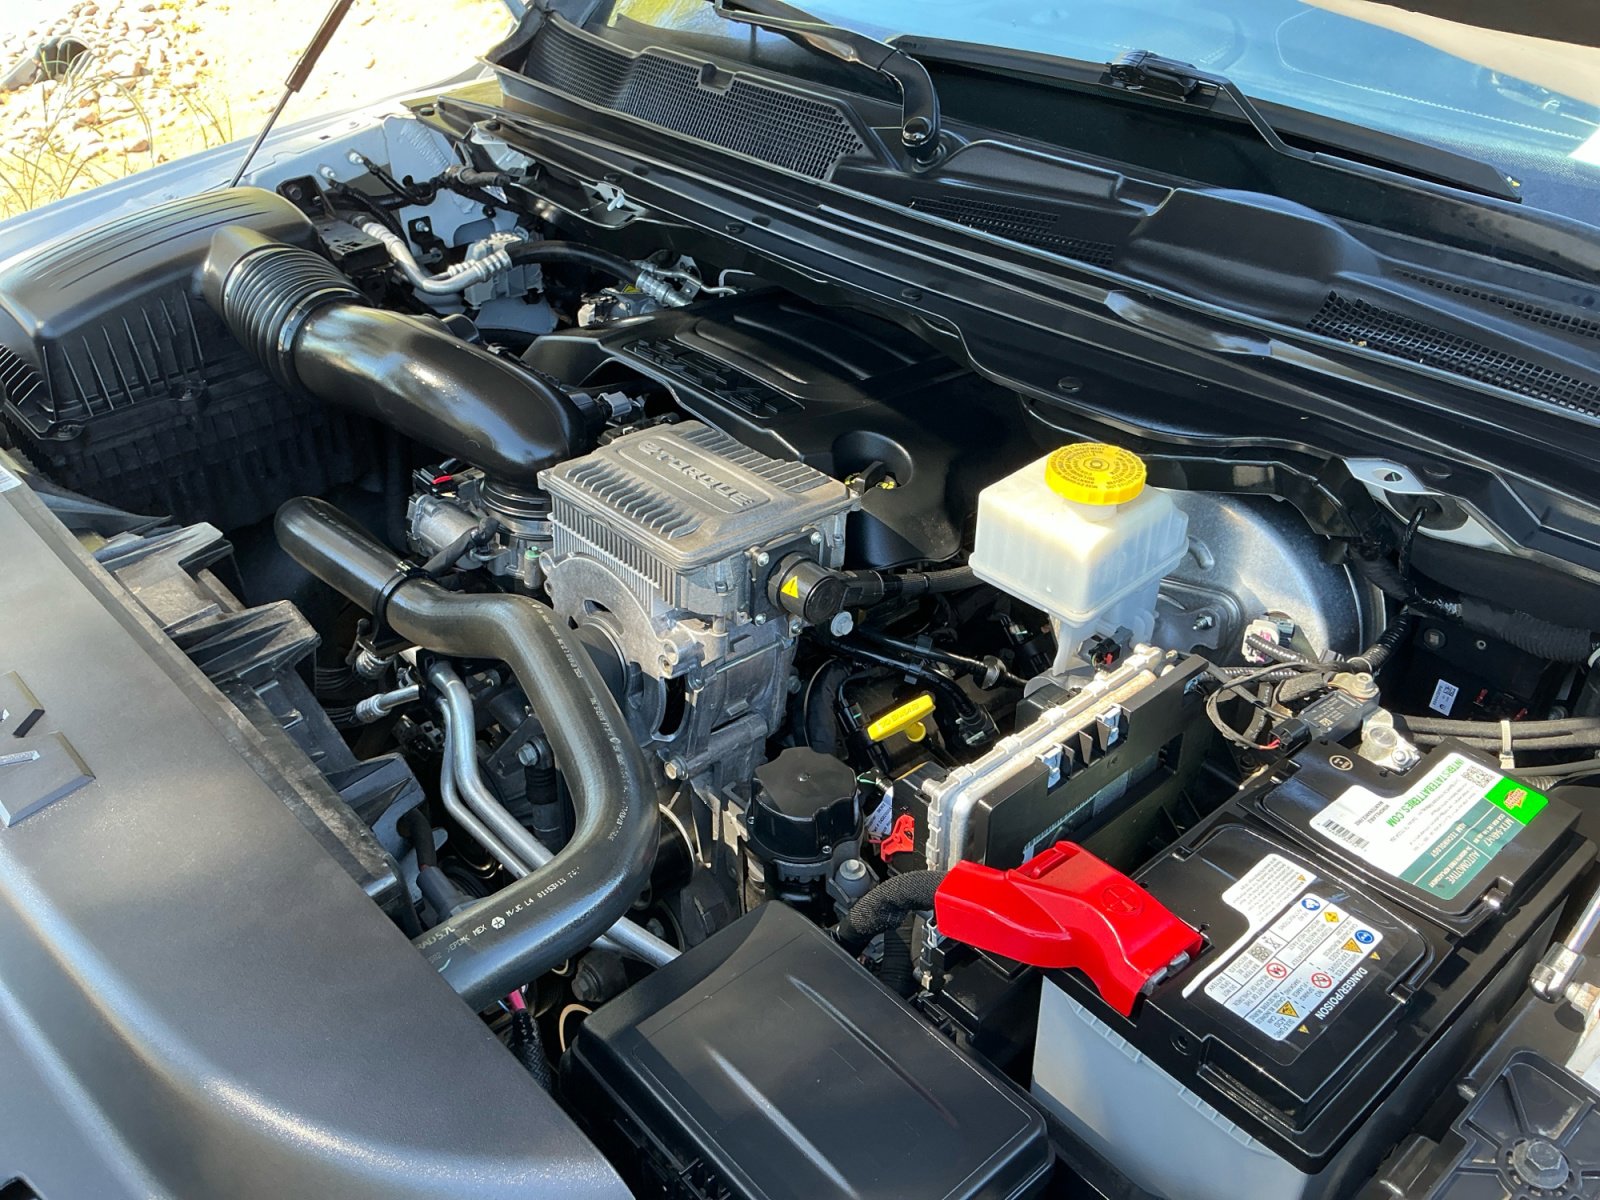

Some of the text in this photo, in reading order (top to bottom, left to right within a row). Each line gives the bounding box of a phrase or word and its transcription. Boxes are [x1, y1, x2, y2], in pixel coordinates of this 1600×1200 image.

[1384, 757, 1464, 827] INTERSTATEBATTERIES.COM
[1428, 830, 1459, 857] TECHNOLOGY
[1444, 849, 1481, 884] AUTOMOTIVE
[435, 926, 456, 941] 5.7L
[472, 924, 488, 937] MEX
[1313, 989, 1324, 997] NO
[1314, 966, 1368, 1020] DANGER/POISON
[1273, 1016, 1286, 1028] ACID
